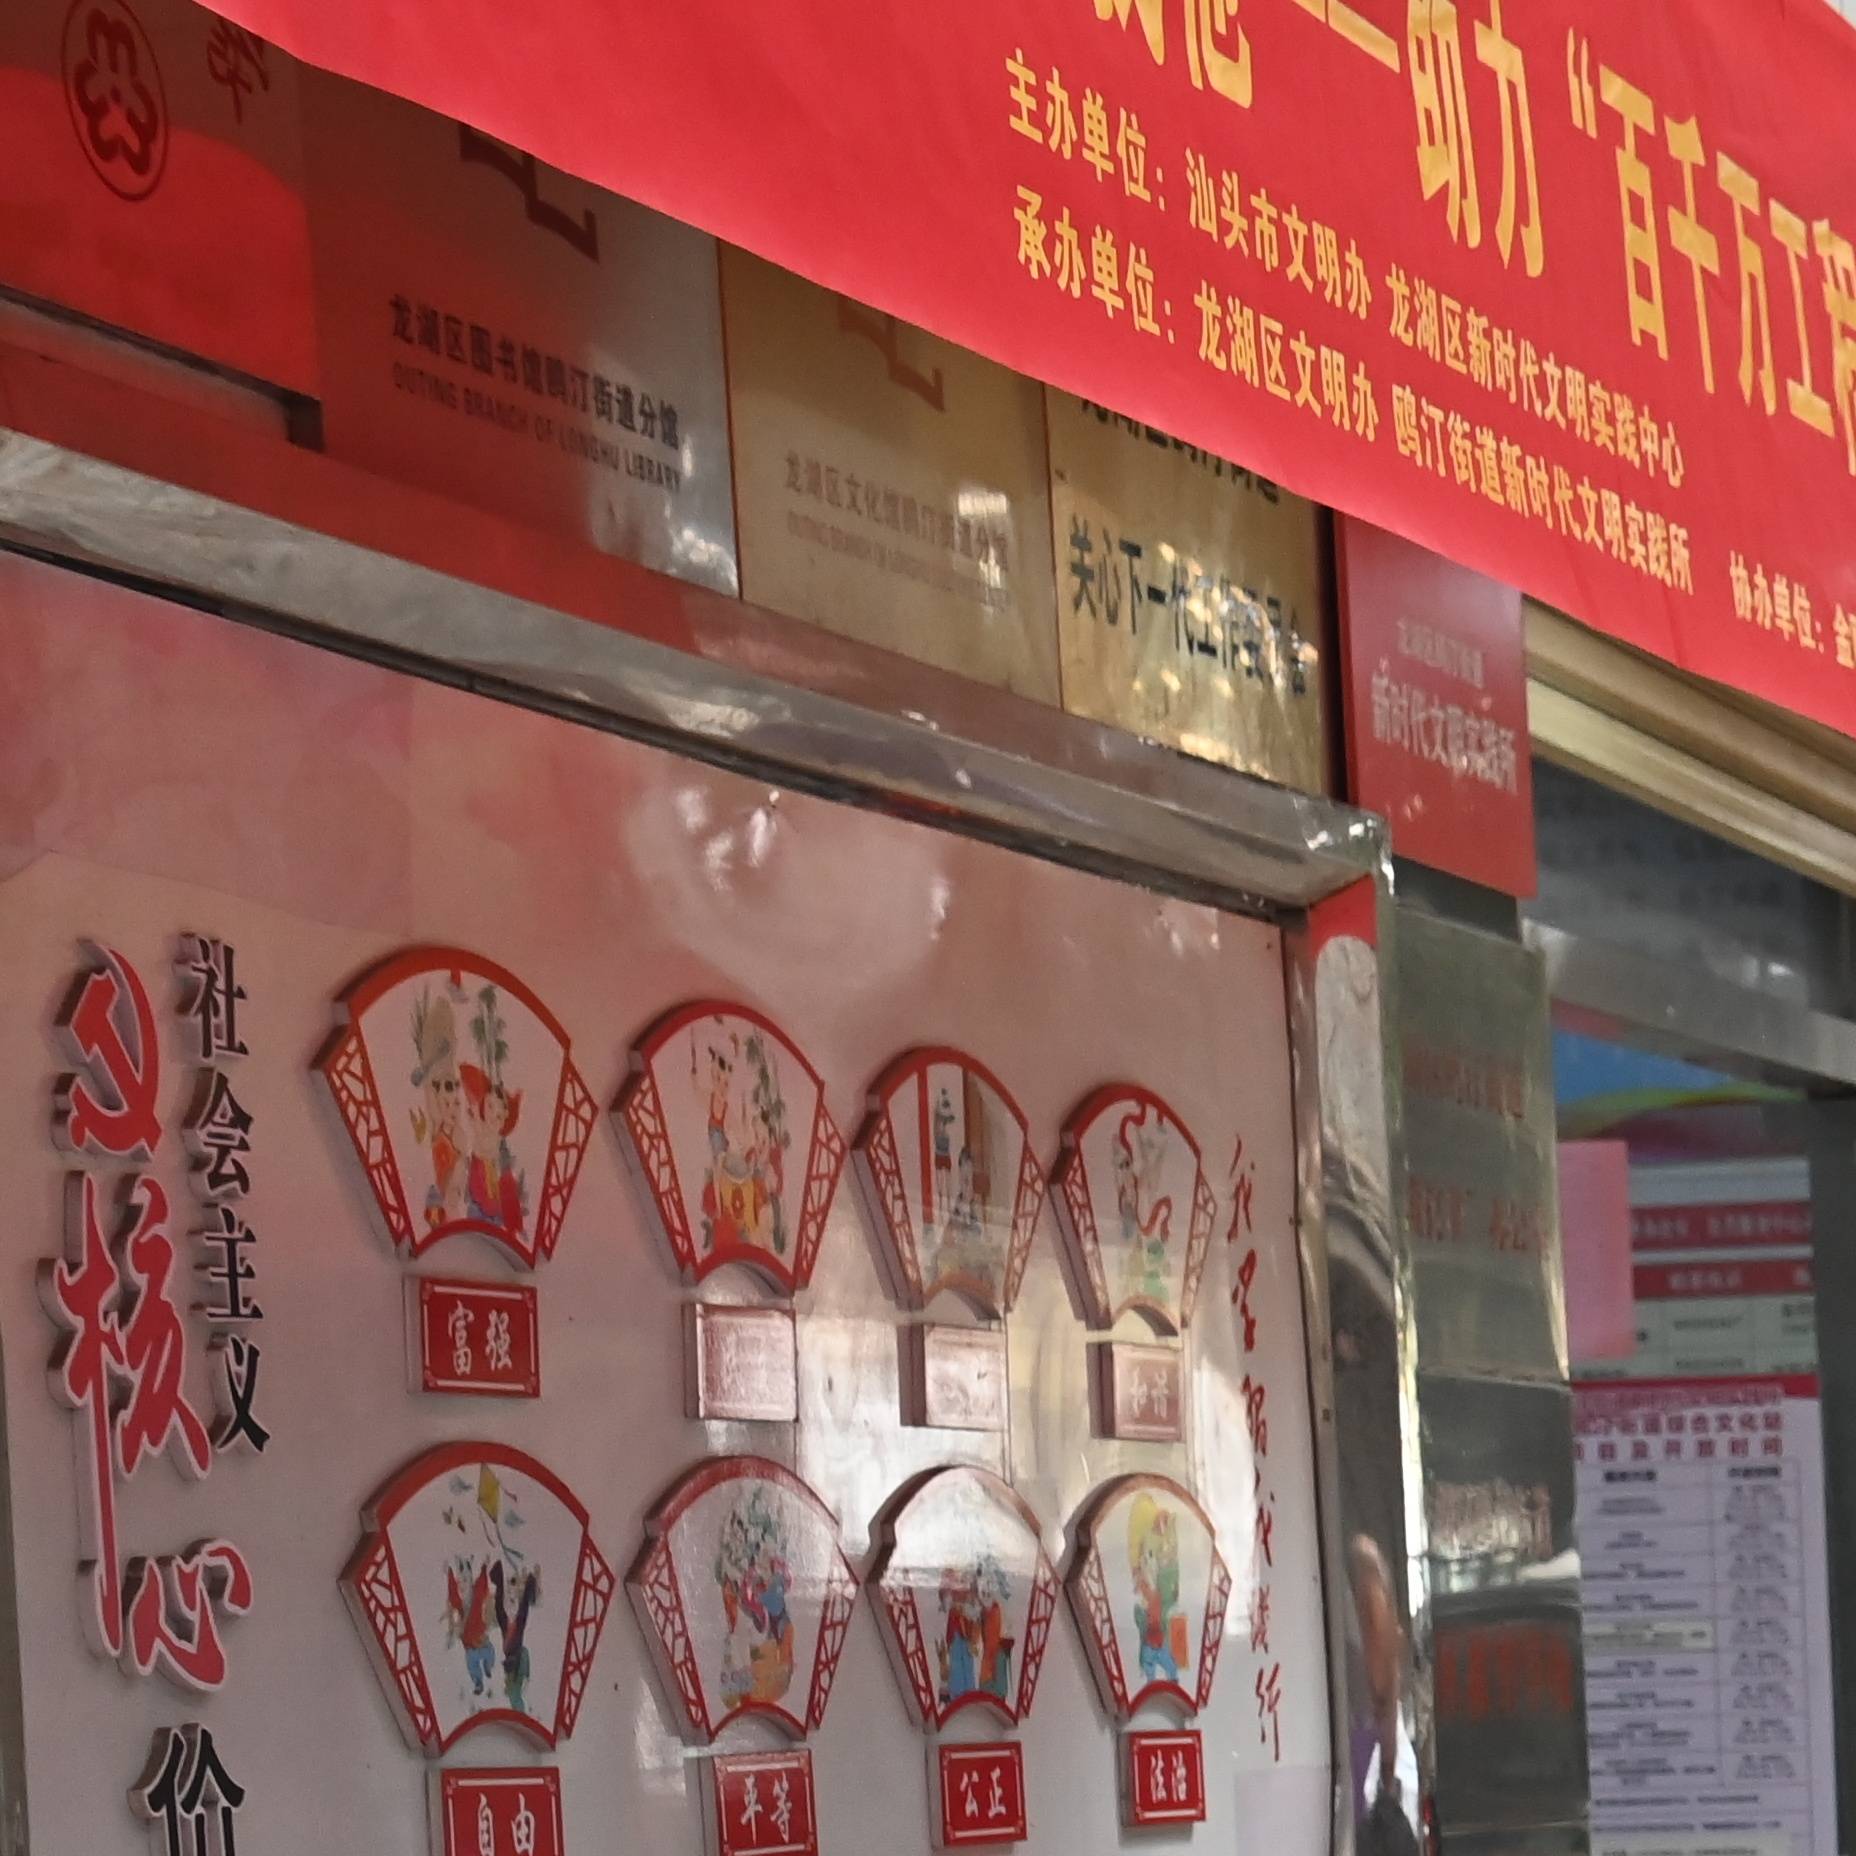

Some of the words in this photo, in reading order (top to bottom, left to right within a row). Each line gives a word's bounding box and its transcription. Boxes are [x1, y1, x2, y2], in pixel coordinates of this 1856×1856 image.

[1386, 262, 1684, 488] 龙湖区新时代文明实践中心
[1391, 382, 1694, 597] 鸥汀街道新时代文明实践所
[193, 940, 271, 1455] 社会主义
[446, 1299, 515, 1378] 富强
[739, 1771, 793, 1845] 平等
[959, 1766, 1007, 1820] 公正
[1149, 1749, 1187, 1804] 法治
